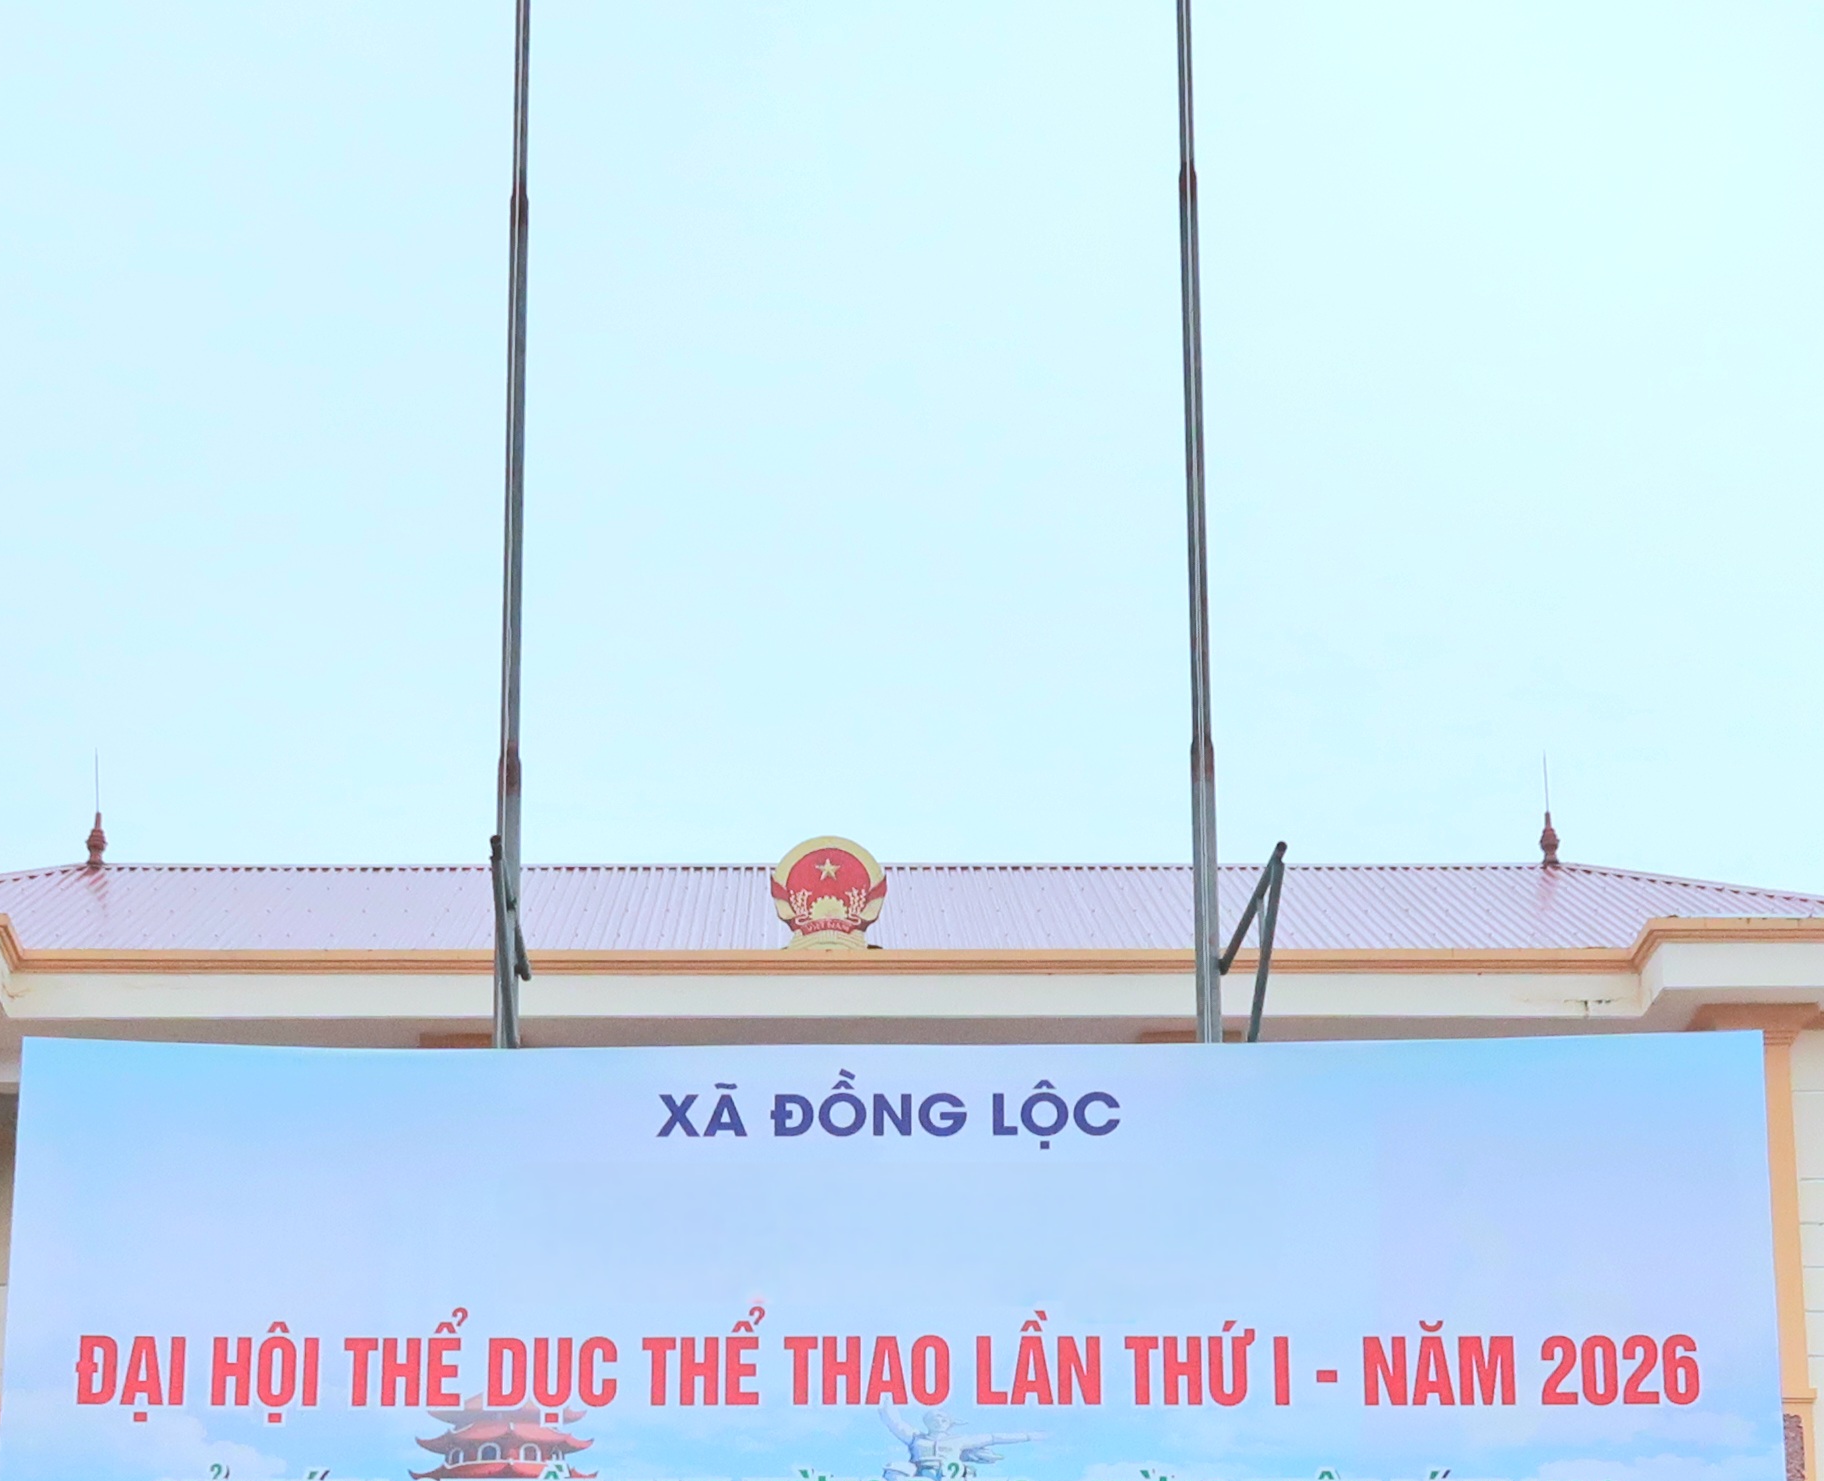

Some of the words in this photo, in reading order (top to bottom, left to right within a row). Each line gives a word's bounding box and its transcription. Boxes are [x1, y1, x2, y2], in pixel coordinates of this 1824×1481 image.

[656, 1082, 748, 1138] XÃ
[771, 1068, 968, 1138] ĐỒNG
[992, 1079, 1121, 1150] LỘC
[76, 1334, 186, 1423] ĐẠI
[212, 1321, 319, 1424] HỘI
[345, 1307, 468, 1407] THỂ
[488, 1335, 618, 1424] DỤC
[642, 1305, 766, 1406] THỂ
[784, 1334, 950, 1406] THAO
[976, 1310, 1101, 1406] LẦN
[1124, 1320, 1255, 1406] THỨ
[1274, 1335, 1290, 1406] I
[1316, 1368, 1338, 1384] -
[1363, 1320, 1514, 1406] NĂM
[1540, 1333, 1699, 1407] 2026
